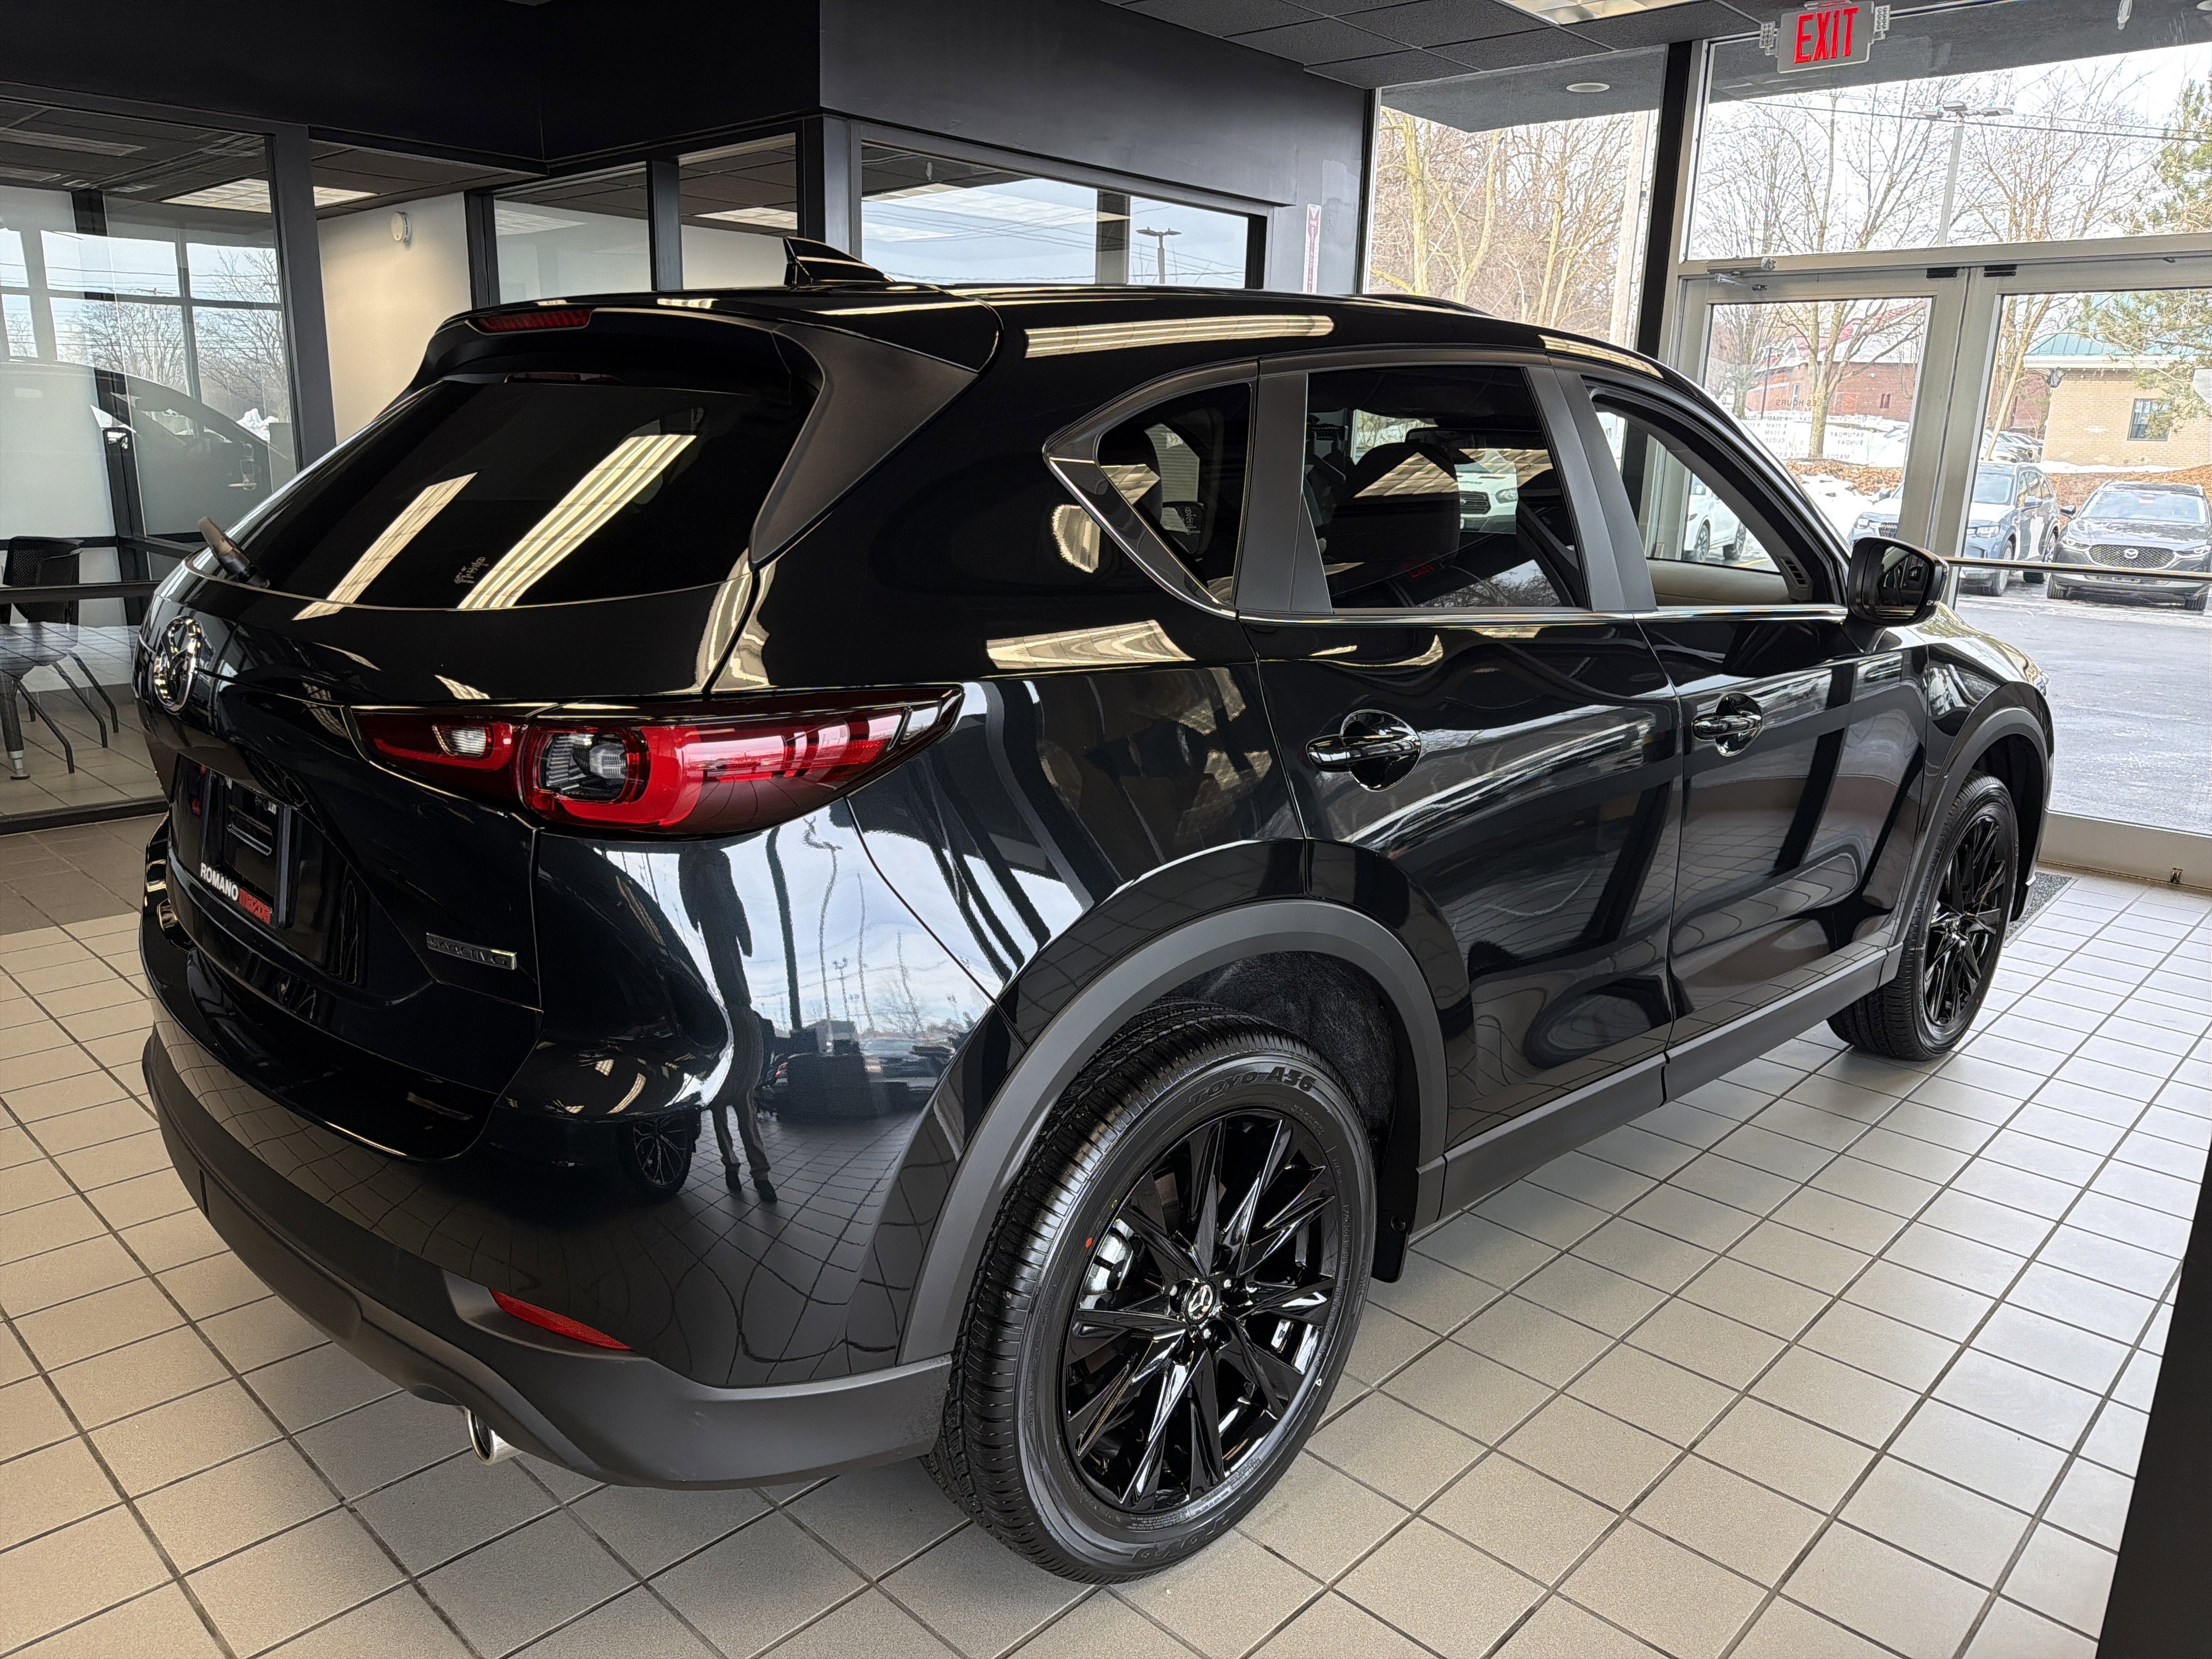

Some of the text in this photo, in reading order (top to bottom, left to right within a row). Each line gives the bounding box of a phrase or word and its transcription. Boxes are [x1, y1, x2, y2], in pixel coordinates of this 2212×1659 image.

[1794, 6, 1859, 64] EXIT
[200, 862, 239, 901] ROMANO
[1188, 1066, 1317, 1104] TOYO A36
